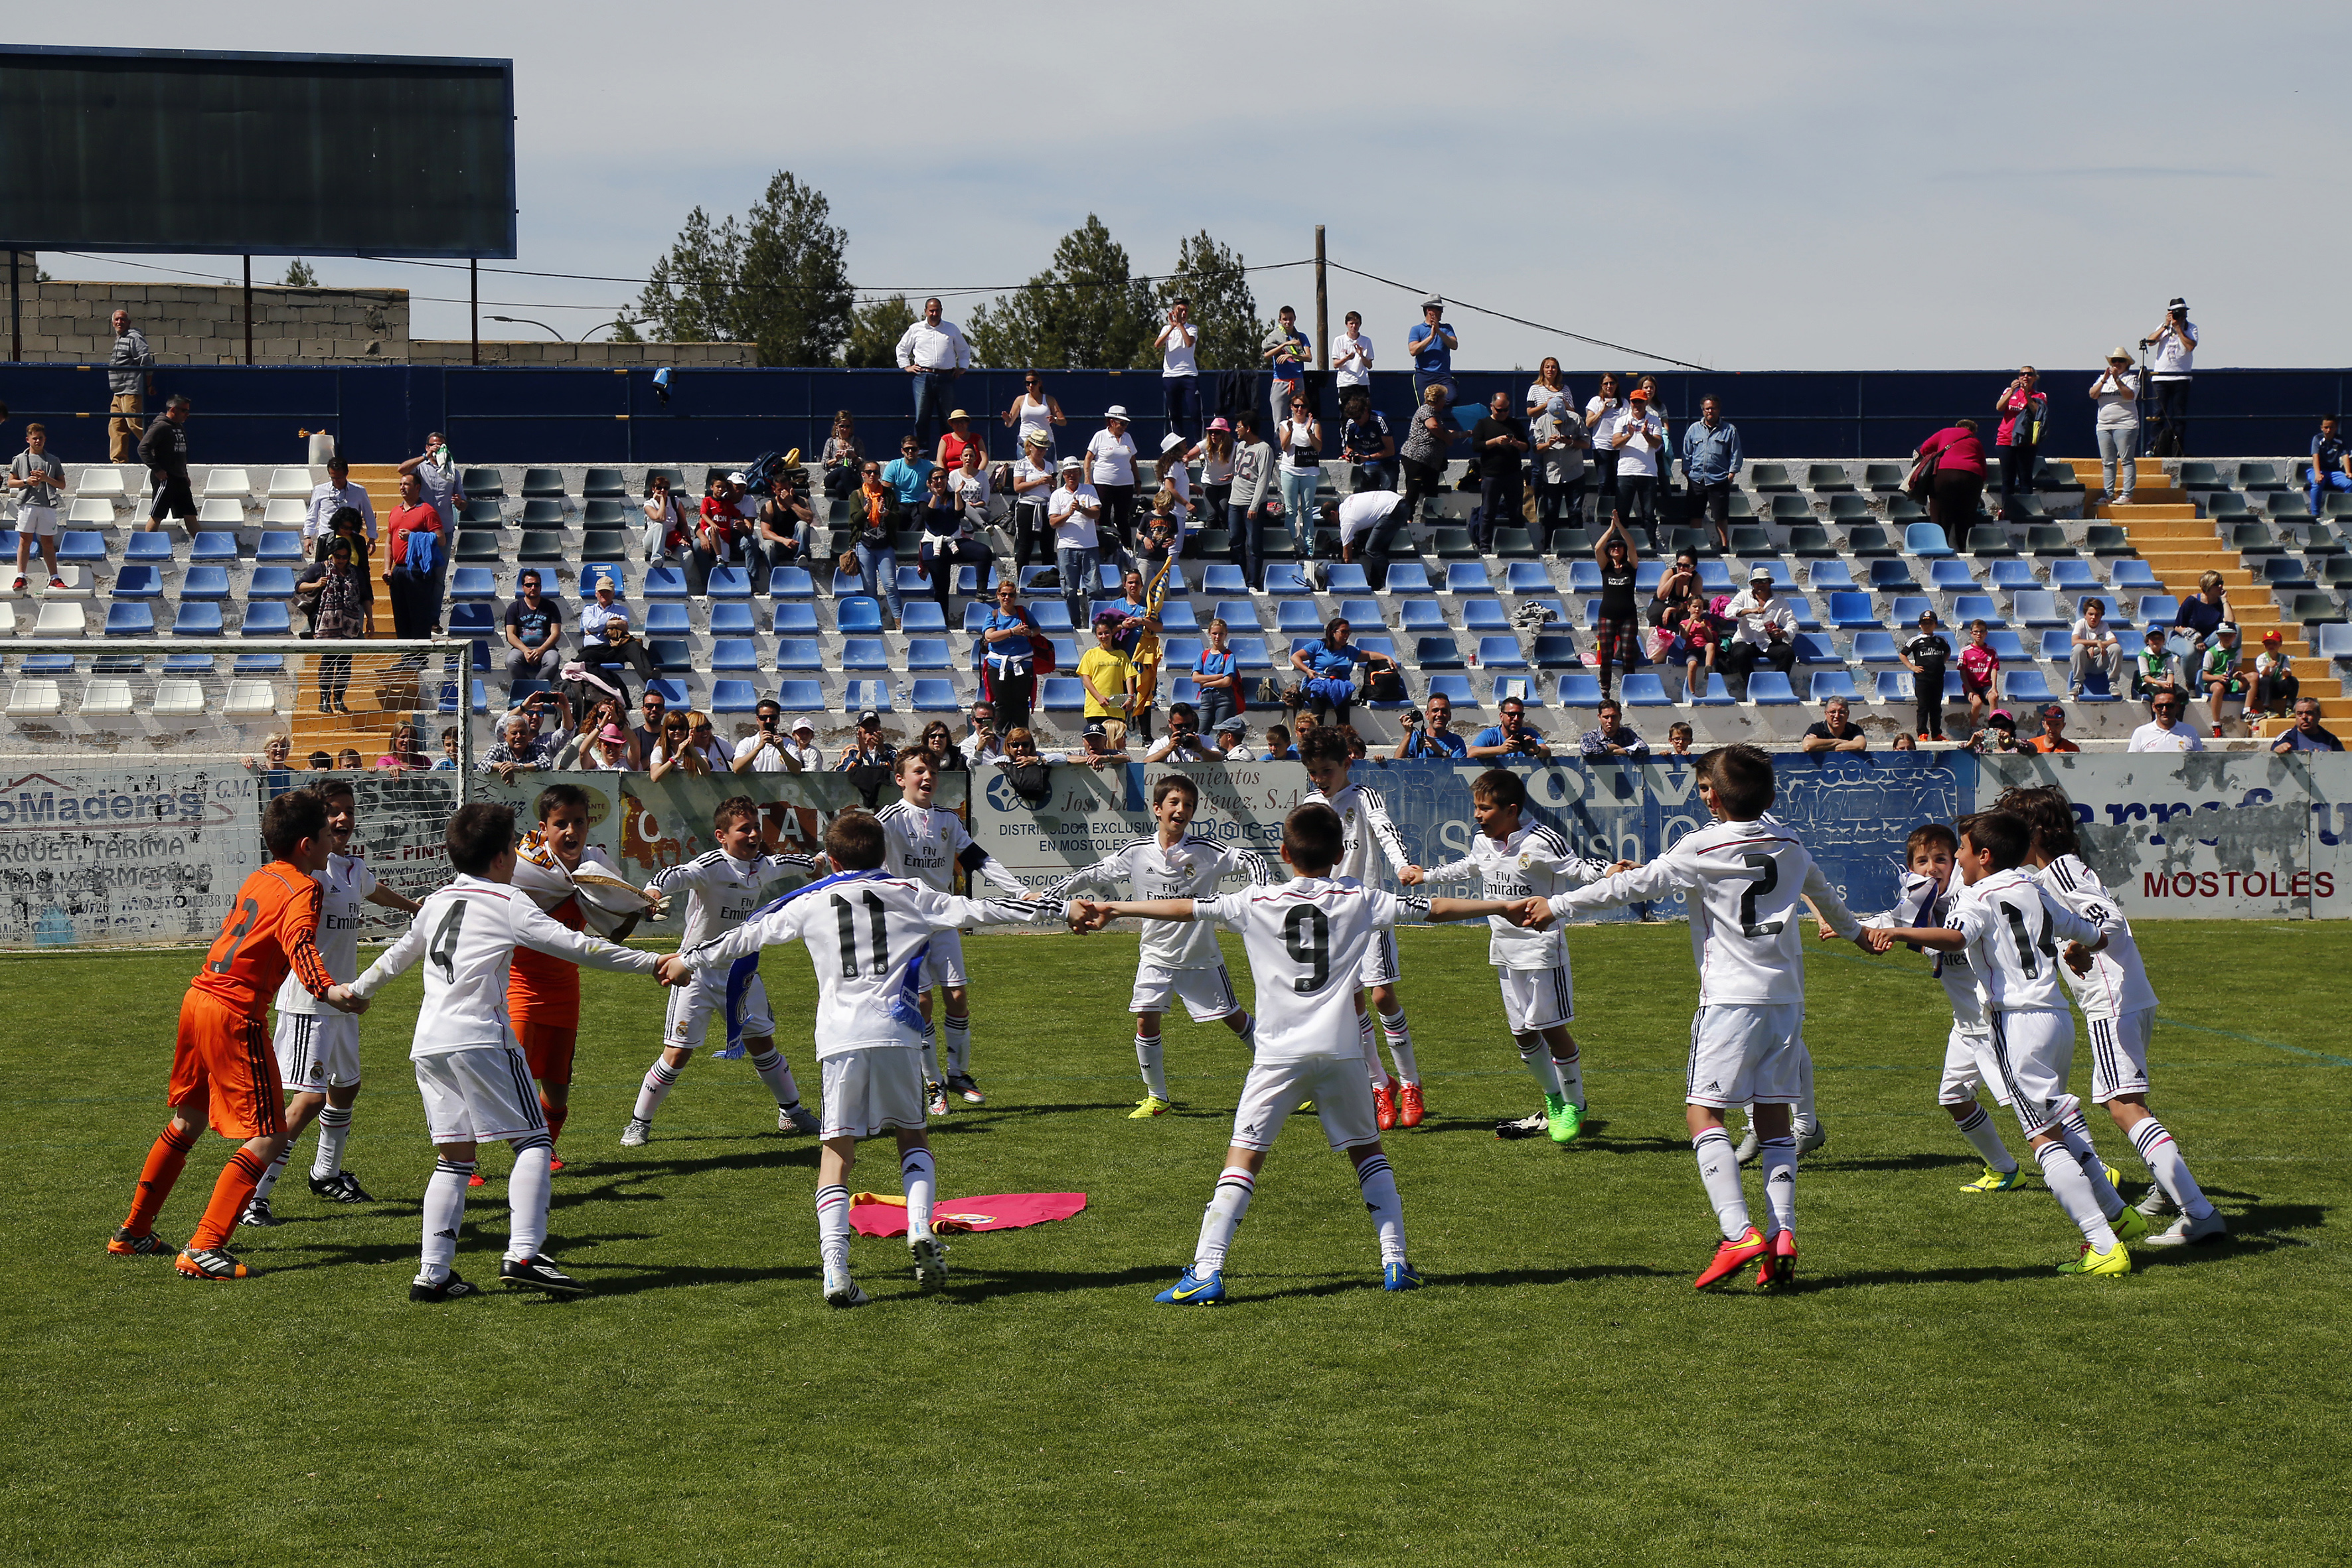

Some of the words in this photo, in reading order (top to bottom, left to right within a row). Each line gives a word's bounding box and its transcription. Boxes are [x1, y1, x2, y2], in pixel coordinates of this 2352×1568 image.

[712, 514, 726, 522] AON
[215, 779, 251, 799] G.M.
[1190, 818, 1284, 842] Roca
[923, 846, 937, 857] Fly
[1040, 840, 1056, 852] EN
[1495, 871, 1510, 884] Fly
[1162, 883, 1179, 894] Fly
[1484, 882, 1533, 897] Emirates
[2144, 871, 2335, 898] MOSTOLES
[1741, 853, 1783, 937] 2
[348, 902, 360, 915] Fly
[740, 898, 754, 910] Fly
[830, 890, 890, 978] 11
[430, 900, 468, 984] 4
[1285, 903, 1329, 992] 9
[645, 1082, 657, 1094] RM
[779, 1119, 793, 1130] CR
